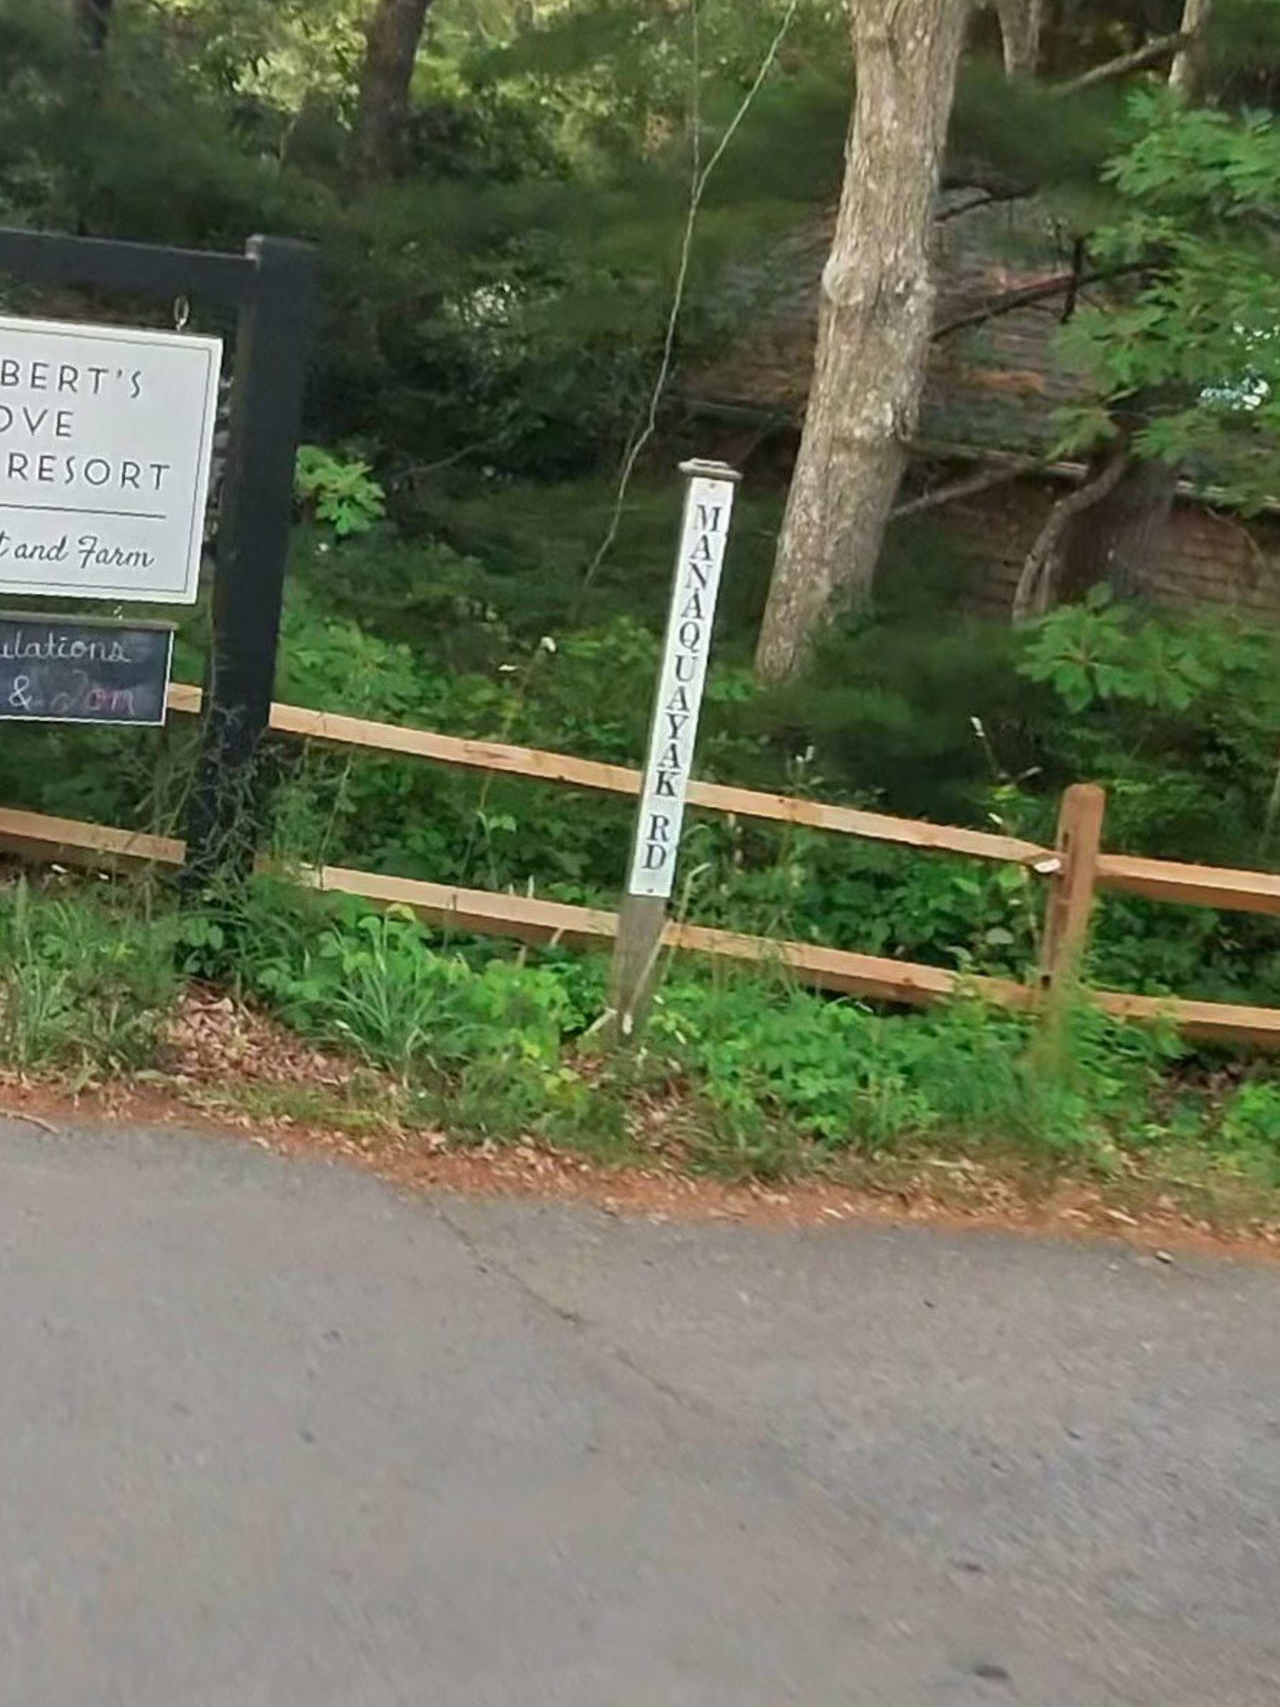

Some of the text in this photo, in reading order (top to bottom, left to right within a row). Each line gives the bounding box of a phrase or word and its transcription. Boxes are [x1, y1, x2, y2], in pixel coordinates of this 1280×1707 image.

[8, 453, 172, 491] RESORT
[14, 533, 68, 563] and
[77, 537, 156, 570] Farm
[8, 675, 33, 710] &
[640, 505, 722, 870] MANAQUAYAK RD
